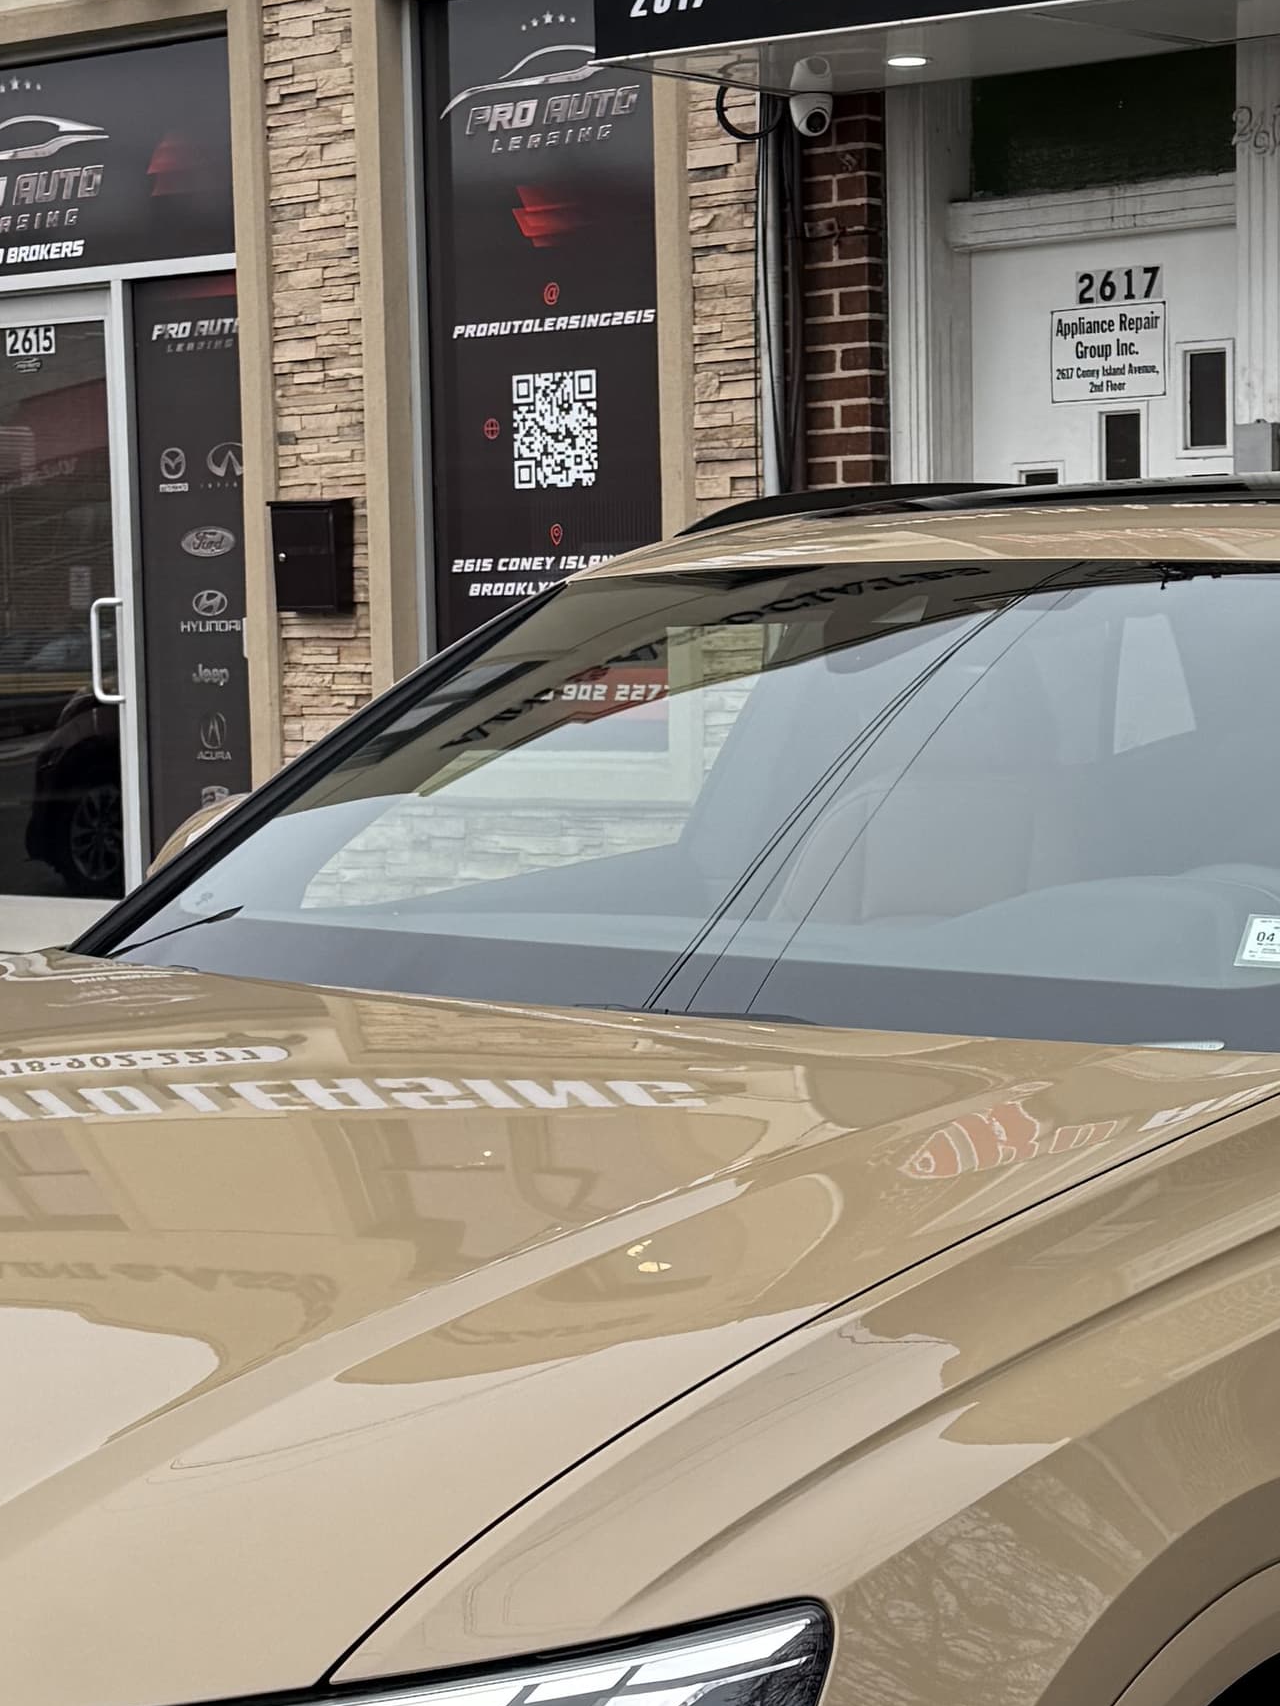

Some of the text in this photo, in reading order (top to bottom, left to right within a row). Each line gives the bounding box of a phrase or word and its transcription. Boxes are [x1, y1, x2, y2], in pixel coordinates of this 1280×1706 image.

[466, 85, 640, 135] PRO AUTO
[492, 124, 613, 154] LEASING
[13, 165, 105, 206] AUTO
[6, 239, 85, 264] BROKERS
[1078, 266, 1160, 304] 2617
[152, 321, 192, 341] PRO
[453, 309, 656, 340] PROAUTOLEASING2615
[1055, 310, 1161, 340] Appliance Repair
[8, 327, 53, 354] 2615
[1075, 338, 1139, 361] Group Inc.
[1056, 368, 1074, 380] 2617
[1076, 367, 1100, 379] Coney
[1102, 363, 1126, 376] Island
[1089, 380, 1126, 393] 2nd Floor
[192, 532, 224, 550] Ford
[452, 558, 493, 572] 2615
[497, 556, 556, 572] CONEY
[469, 581, 556, 597] BROOKLY
[181, 620, 241, 633] HYUNDAI
[192, 663, 230, 686] Jeep
[561, 684, 608, 701] 902
[614, 684, 669, 701] 227
[1256, 931, 1275, 943] 04
